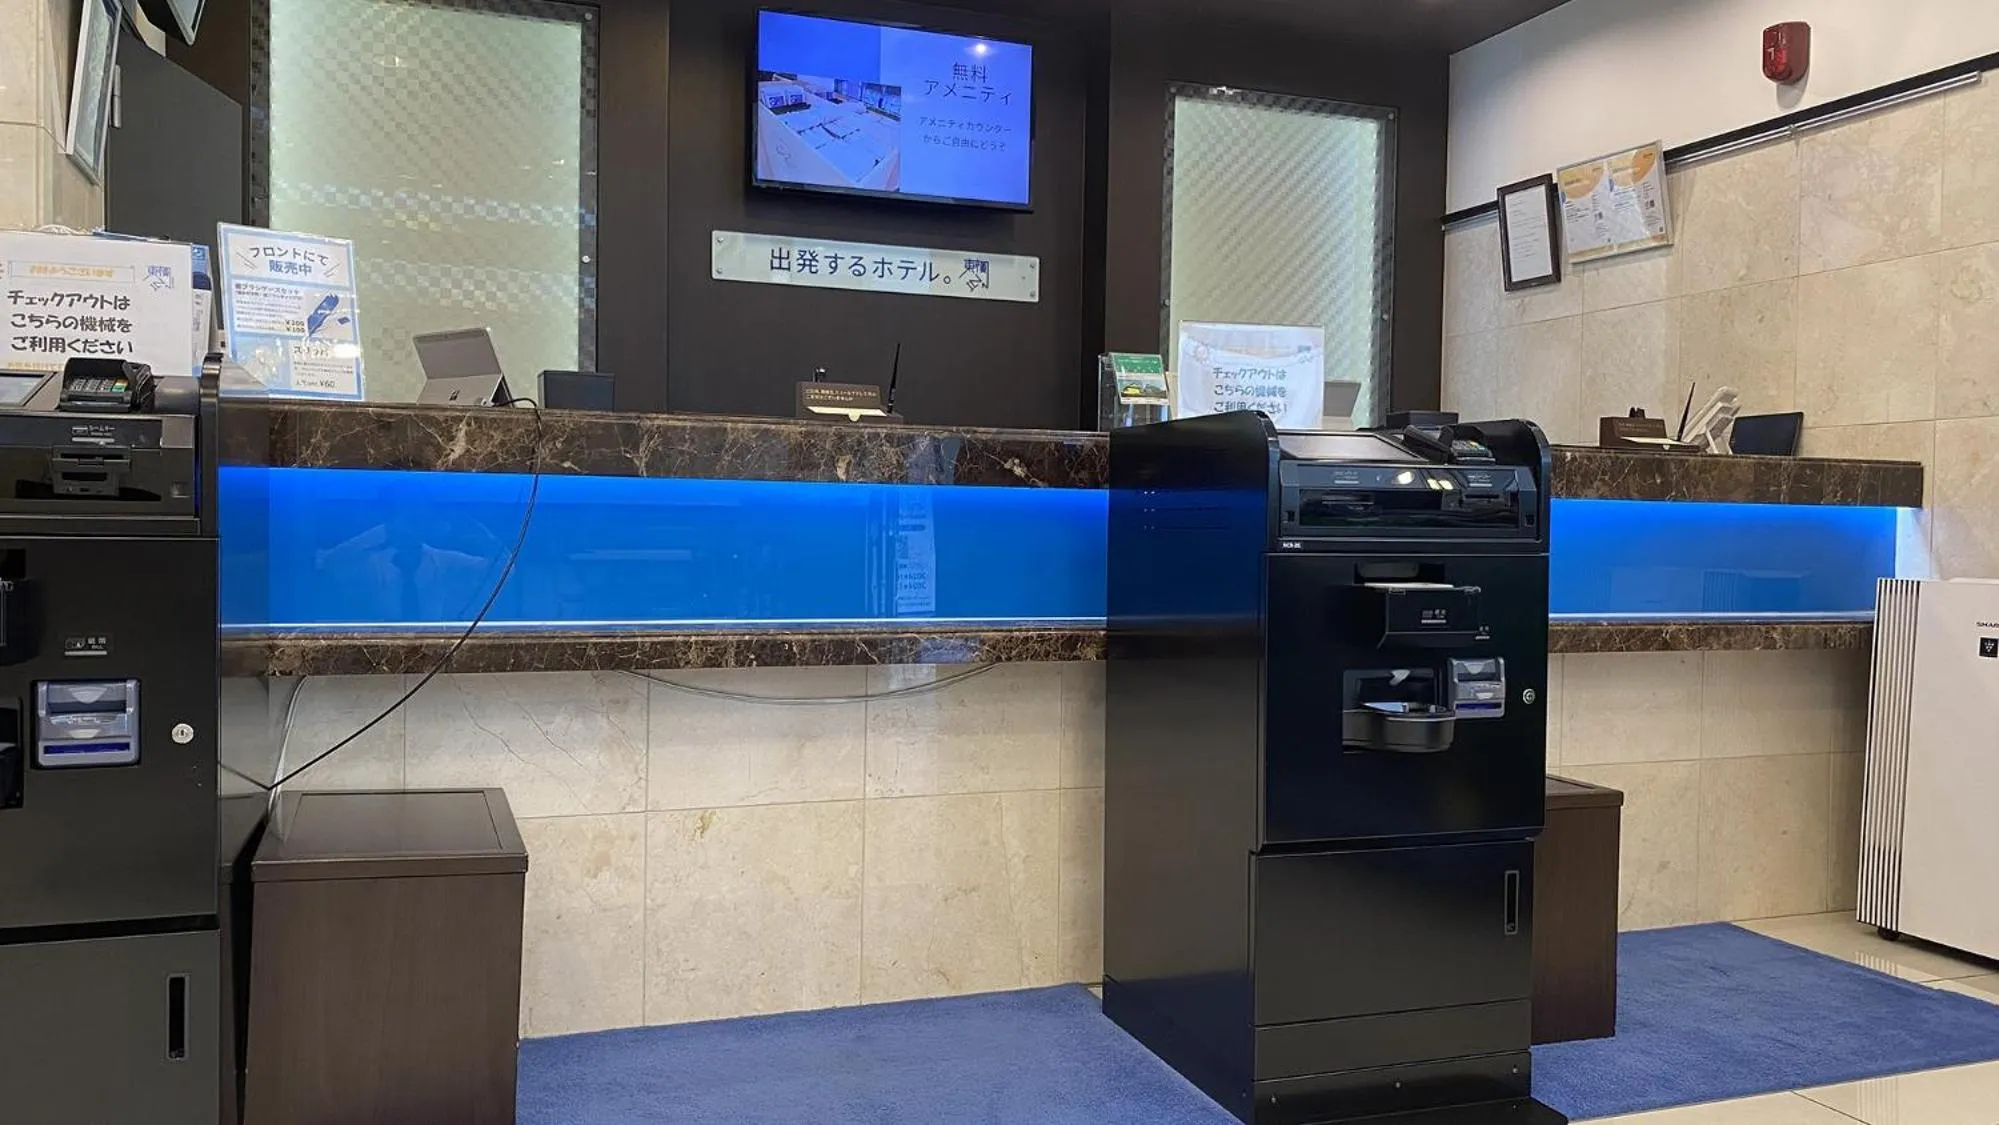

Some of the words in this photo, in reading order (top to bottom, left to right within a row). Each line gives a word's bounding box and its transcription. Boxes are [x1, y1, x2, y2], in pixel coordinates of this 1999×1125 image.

[952, 62, 988, 84] 無料
[924, 80, 1012, 105] アメニティ
[920, 116, 1012, 133] アメニティカウンター
[923, 135, 1007, 152] からご自由にどうぞ
[249, 247, 329, 266] フロントにて
[769, 247, 951, 285] 出発するホテル。
[269, 259, 312, 276] 販売中
[7, 290, 131, 310] チェックアウトは
[11, 313, 133, 333] こちらの機械を
[11, 336, 133, 354] ご利用ください
[1213, 367, 1288, 380] チェックアウトは
